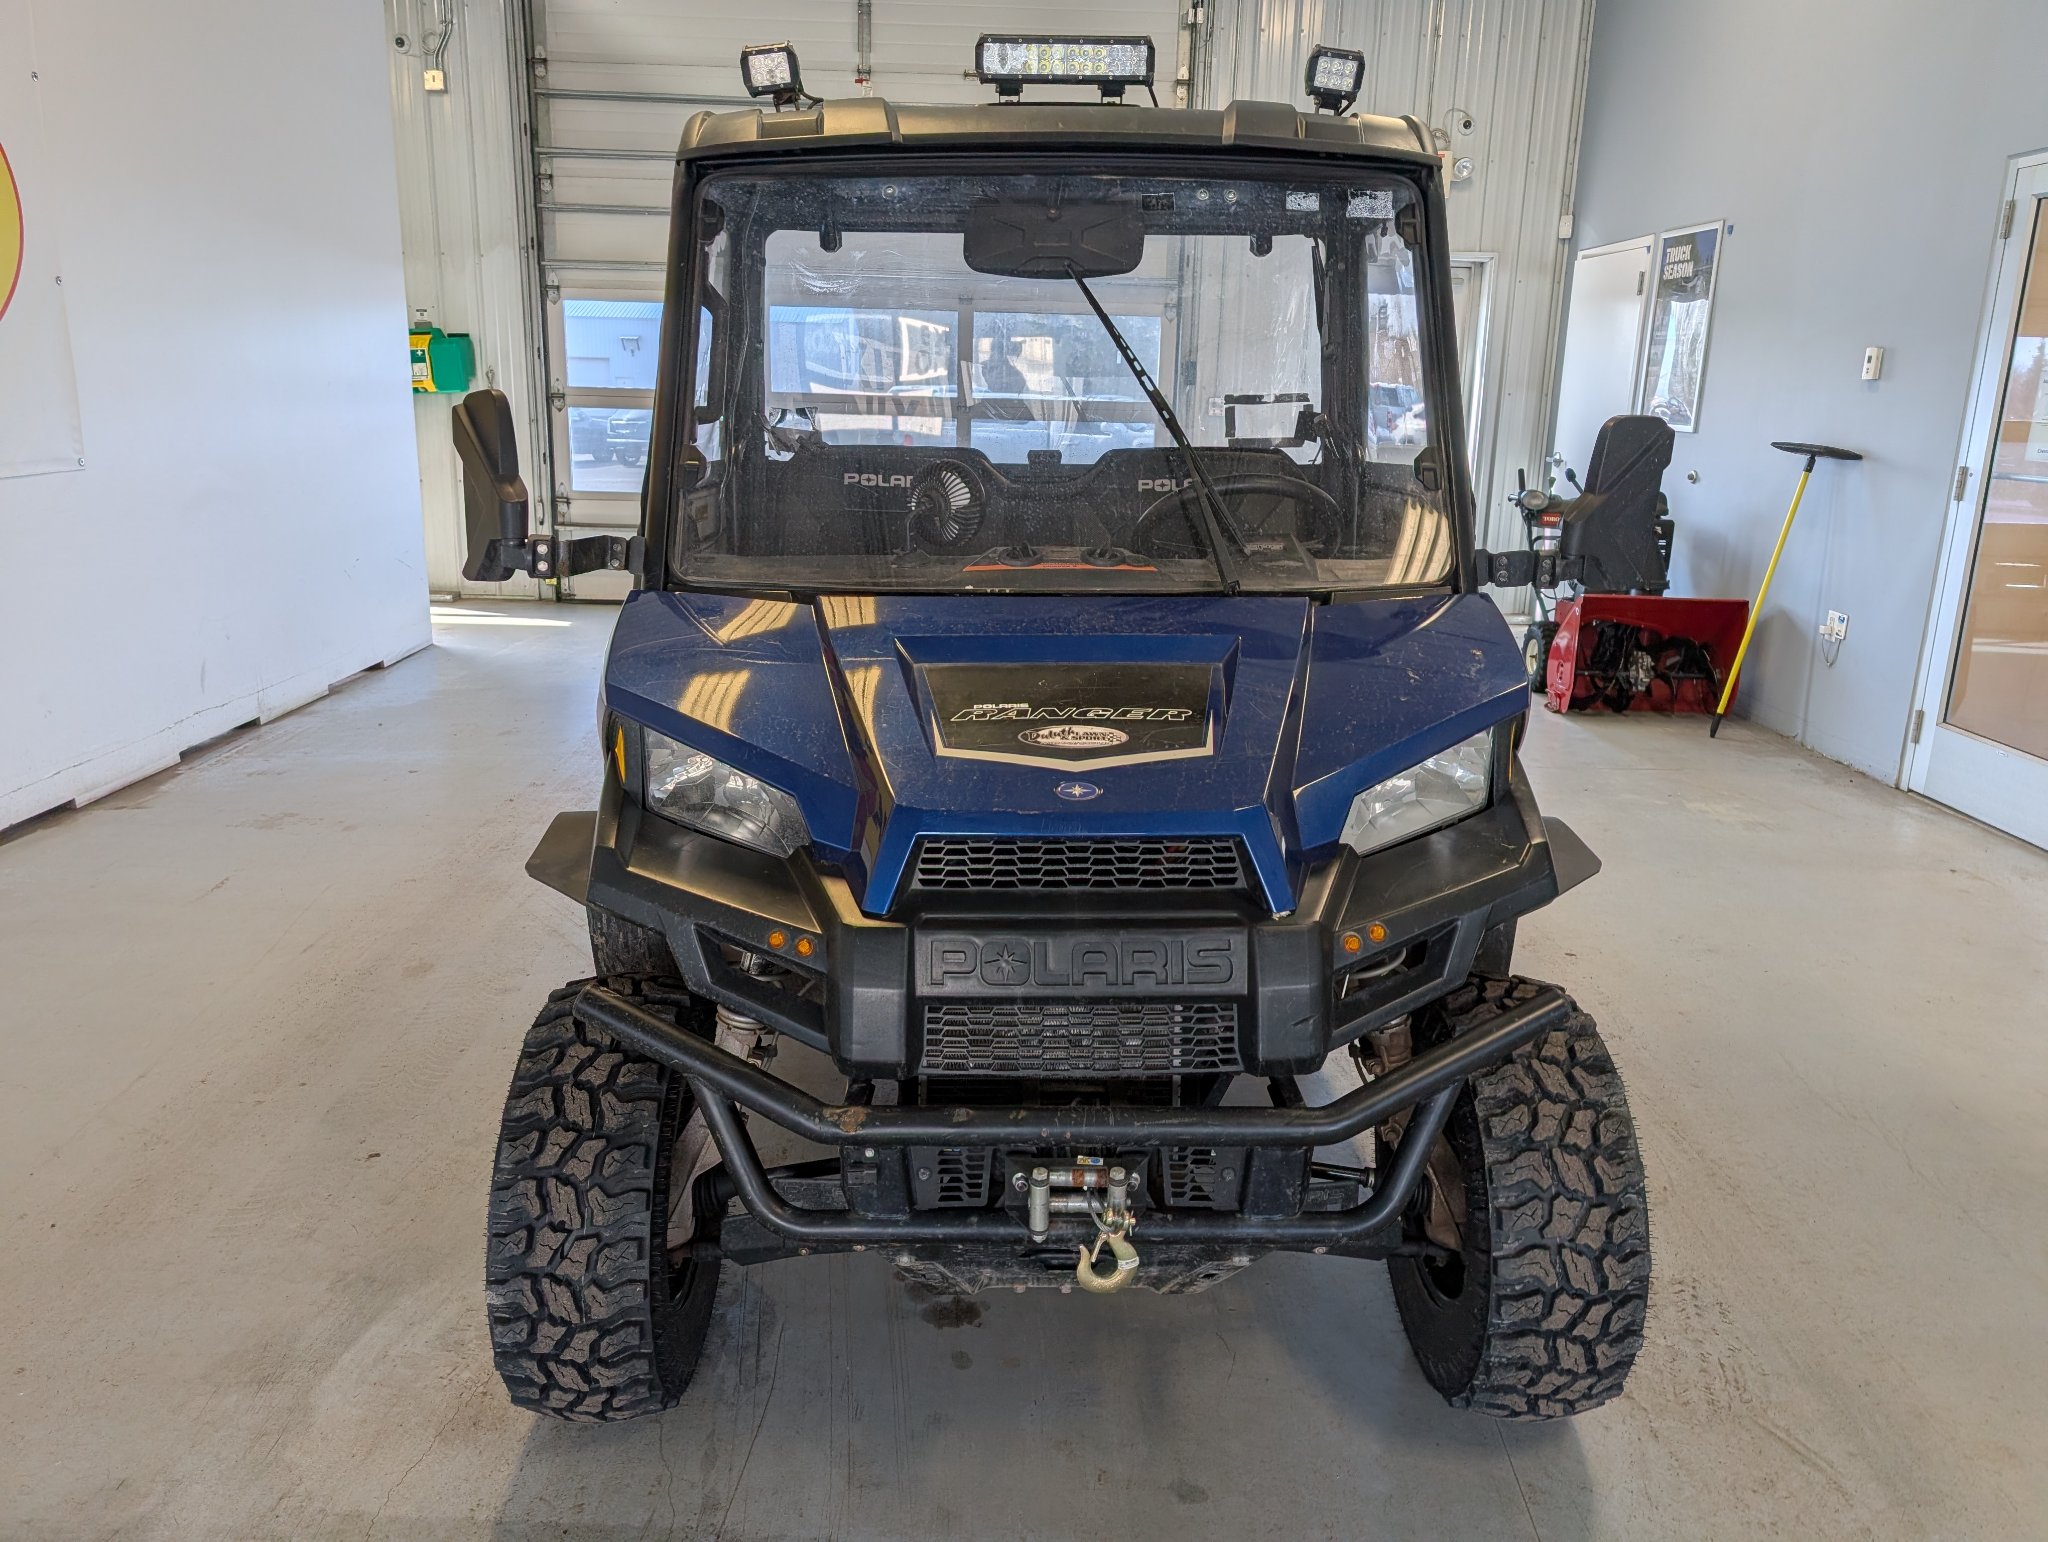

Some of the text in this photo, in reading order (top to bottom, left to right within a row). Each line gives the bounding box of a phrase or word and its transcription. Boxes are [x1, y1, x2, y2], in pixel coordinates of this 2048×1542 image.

[1666, 244, 1692, 263] TRUCK
[1663, 261, 1694, 280] SEASON
[951, 707, 1193, 722] RANGER
[1028, 726, 1075, 741] Duluth
[930, 938, 1234, 986] POLARIS
